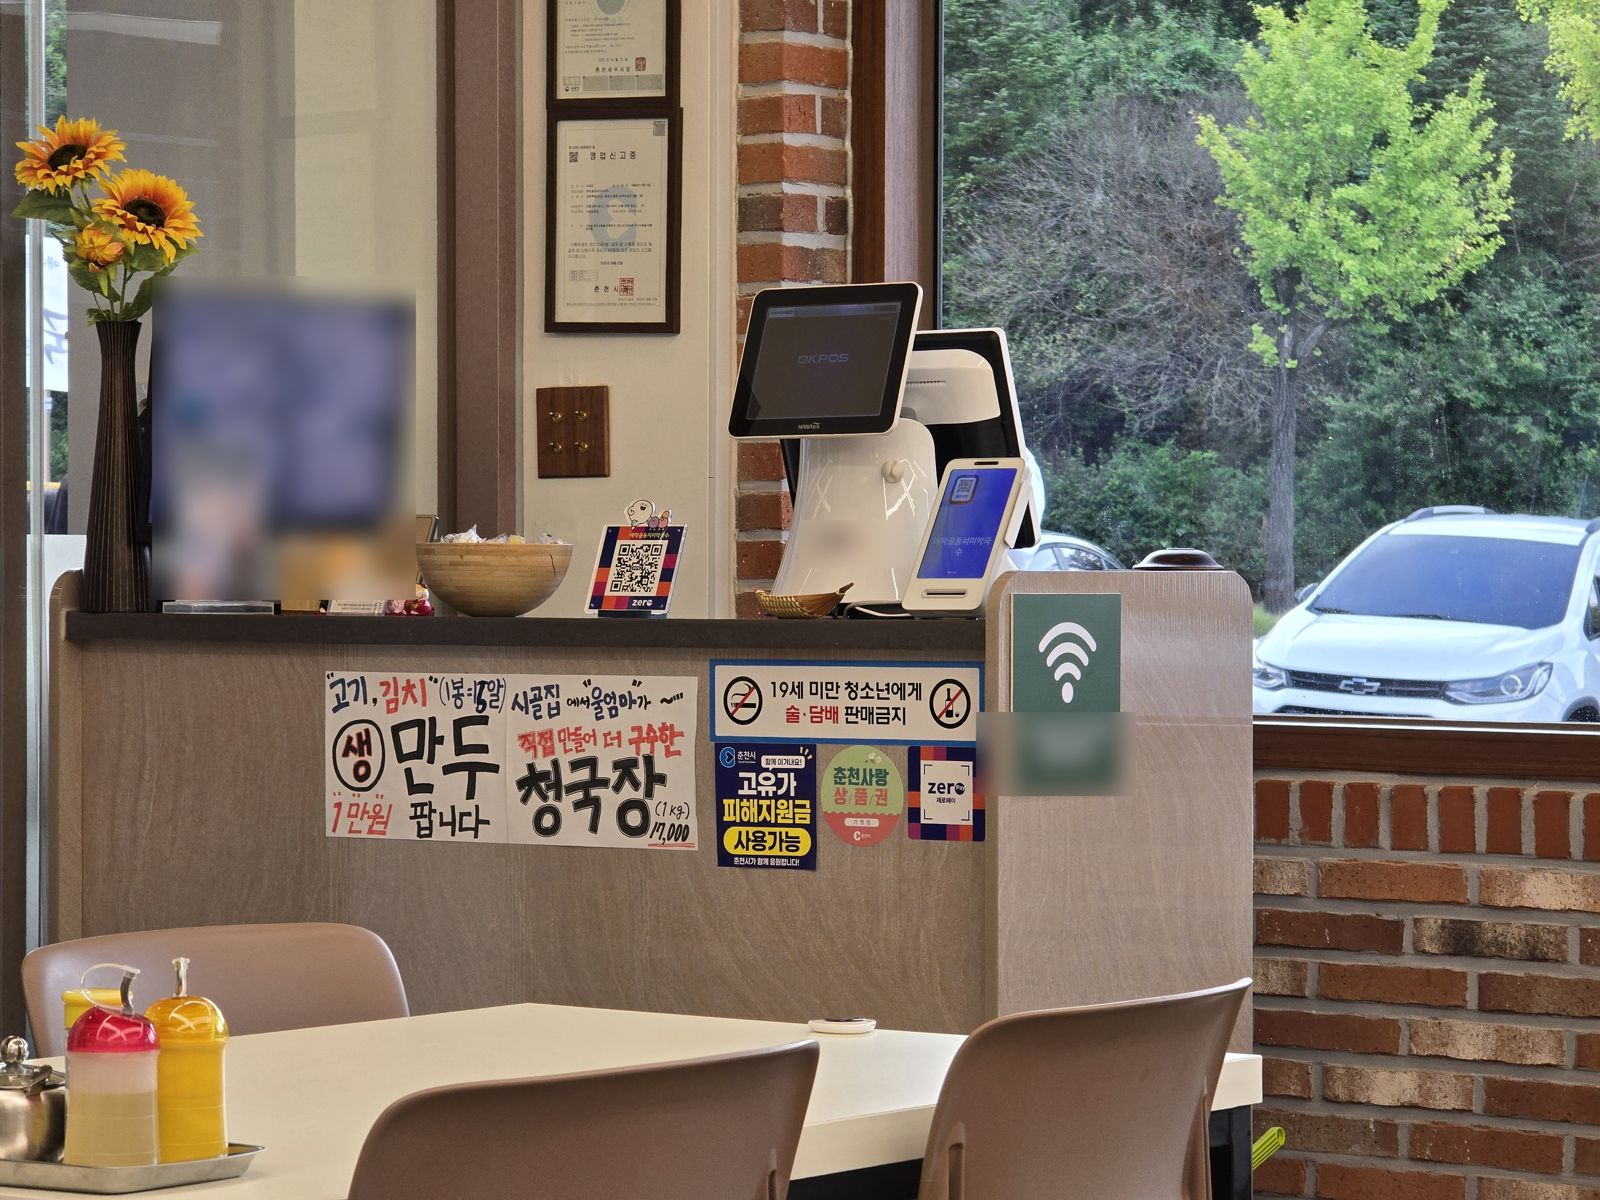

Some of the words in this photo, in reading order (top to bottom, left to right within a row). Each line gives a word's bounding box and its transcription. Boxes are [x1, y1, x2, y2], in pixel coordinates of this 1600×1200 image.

[511, 684, 561, 720] 시골집
[770, 681, 804, 700] 19세
[809, 681, 841, 700] 미만
[844, 680, 922, 701] 청소년에게
[844, 706, 906, 726] 판매금지
[517, 728, 555, 760] 직접
[557, 726, 597, 754] 만들어
[602, 730, 622, 749] 더
[628, 722, 685, 758] 구수한
[341, 728, 372, 783] 생
[391, 715, 500, 800] 만두
[737, 751, 756, 760] 춘천시
[738, 771, 797, 797] 고유가
[833, 766, 889, 787] 춘천사랑
[515, 754, 668, 838] 청국장
[409, 801, 490, 839] 팝니다
[723, 798, 811, 824] 피해지원금
[734, 830, 801, 852] 사용가능
[734, 857, 757, 865] 춘천시가
